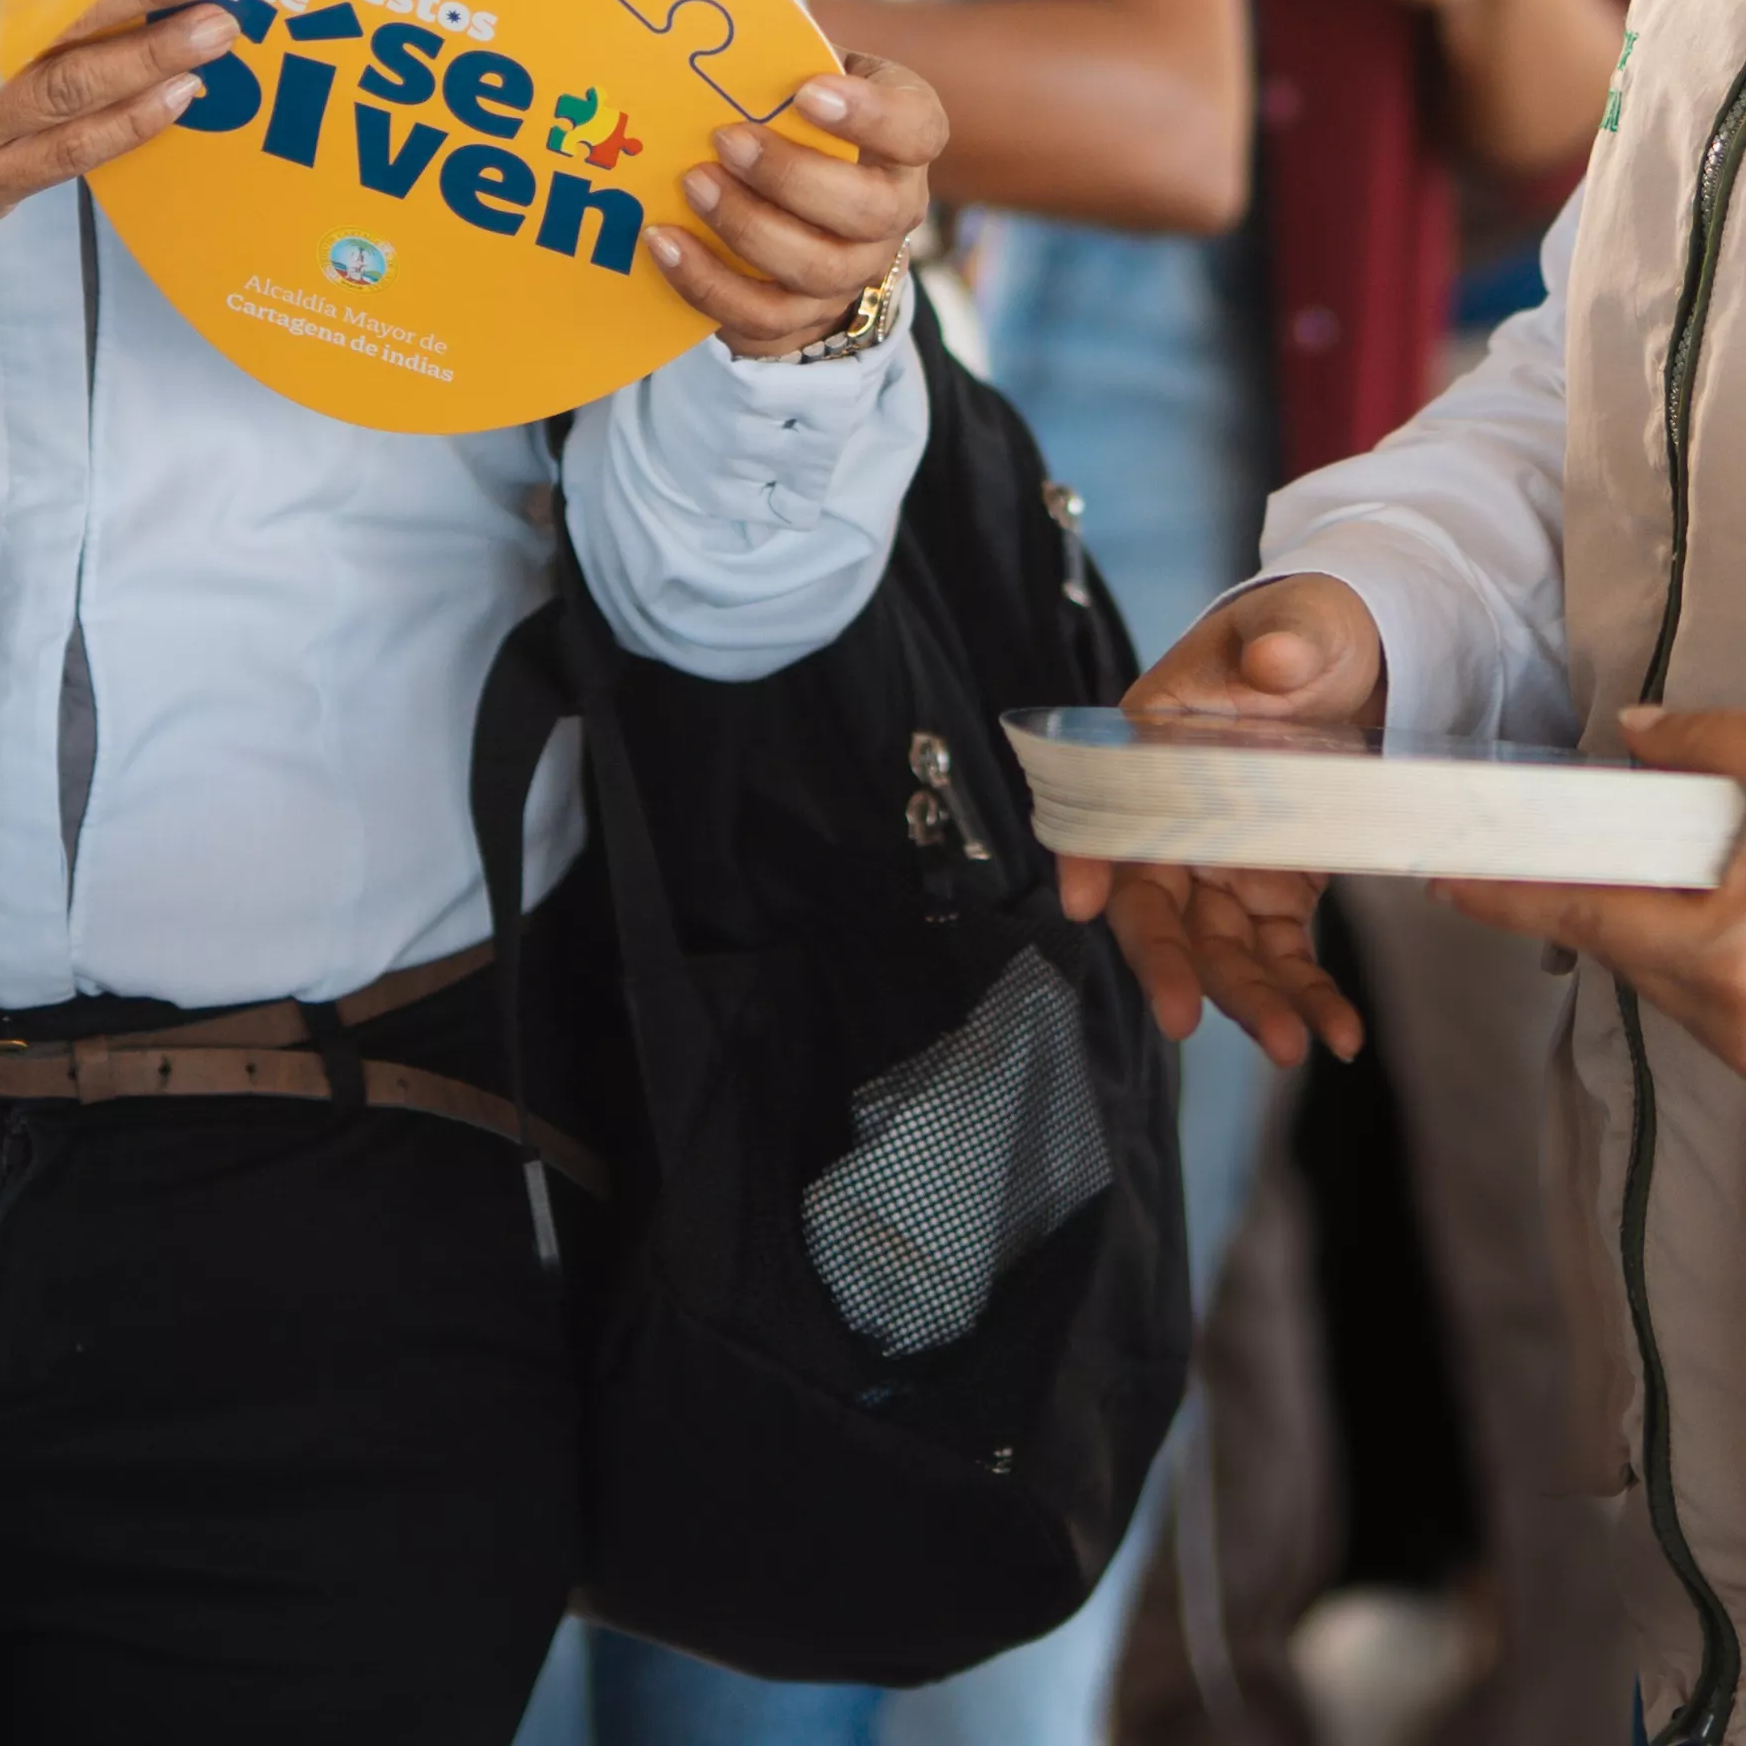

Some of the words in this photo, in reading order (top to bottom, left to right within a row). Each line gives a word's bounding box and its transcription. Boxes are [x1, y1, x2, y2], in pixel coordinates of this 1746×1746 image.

[357, 22, 535, 140] se
[354, 102, 645, 276] ven
[225, 292, 346, 347] Cartagena
[349, 335, 379, 357] de
[380, 343, 456, 383] indias
[244, 274, 338, 320] Alcaldía
[342, 306, 417, 346] Mayor
[418, 333, 449, 356] de
